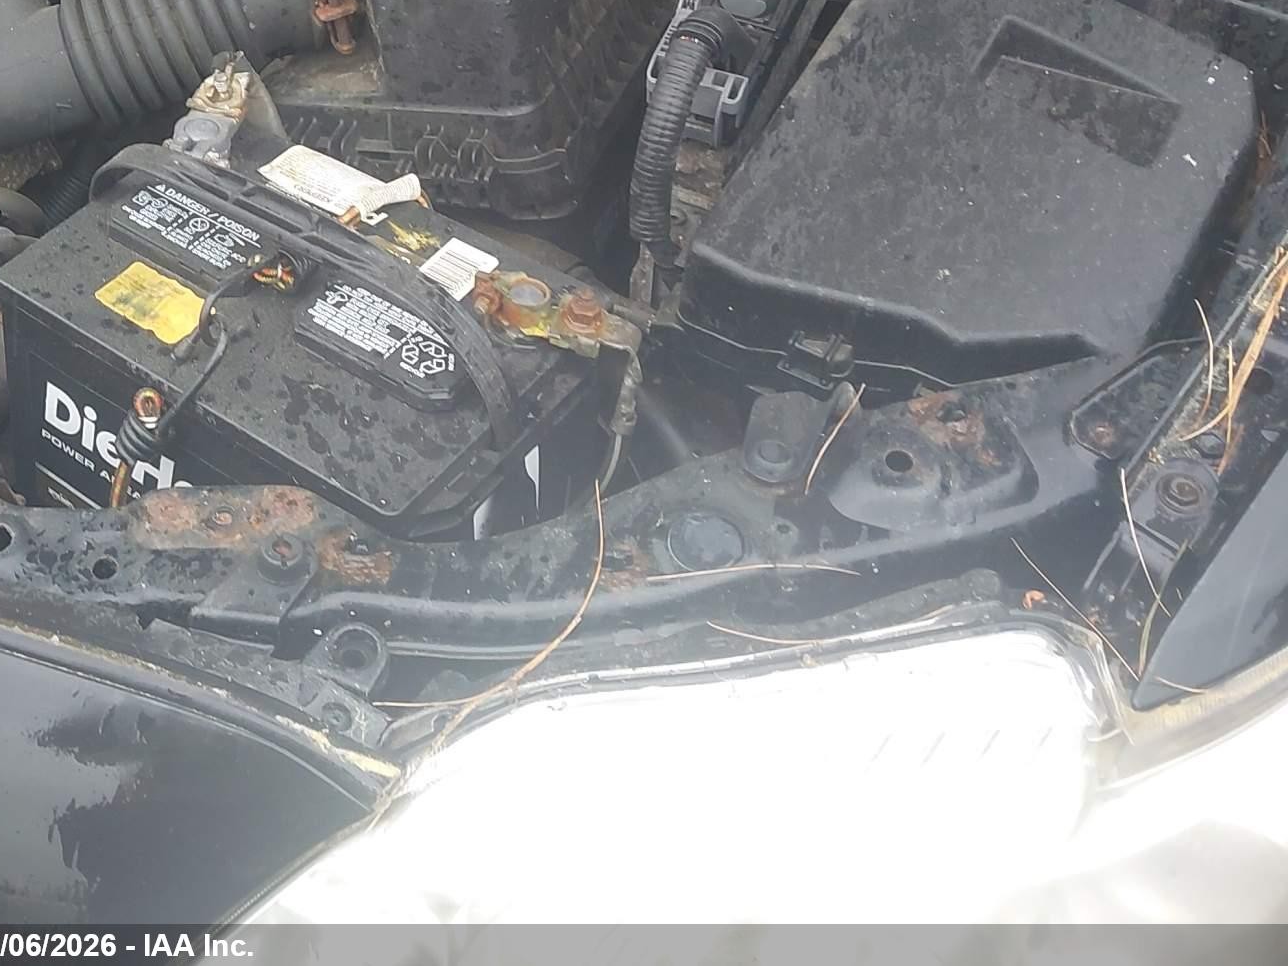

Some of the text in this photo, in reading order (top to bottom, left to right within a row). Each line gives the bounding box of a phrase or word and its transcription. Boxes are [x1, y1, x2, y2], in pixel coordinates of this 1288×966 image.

[165, 188, 211, 215] DANGER
[217, 215, 261, 241] POISON
[41, 428, 95, 472] POWER
